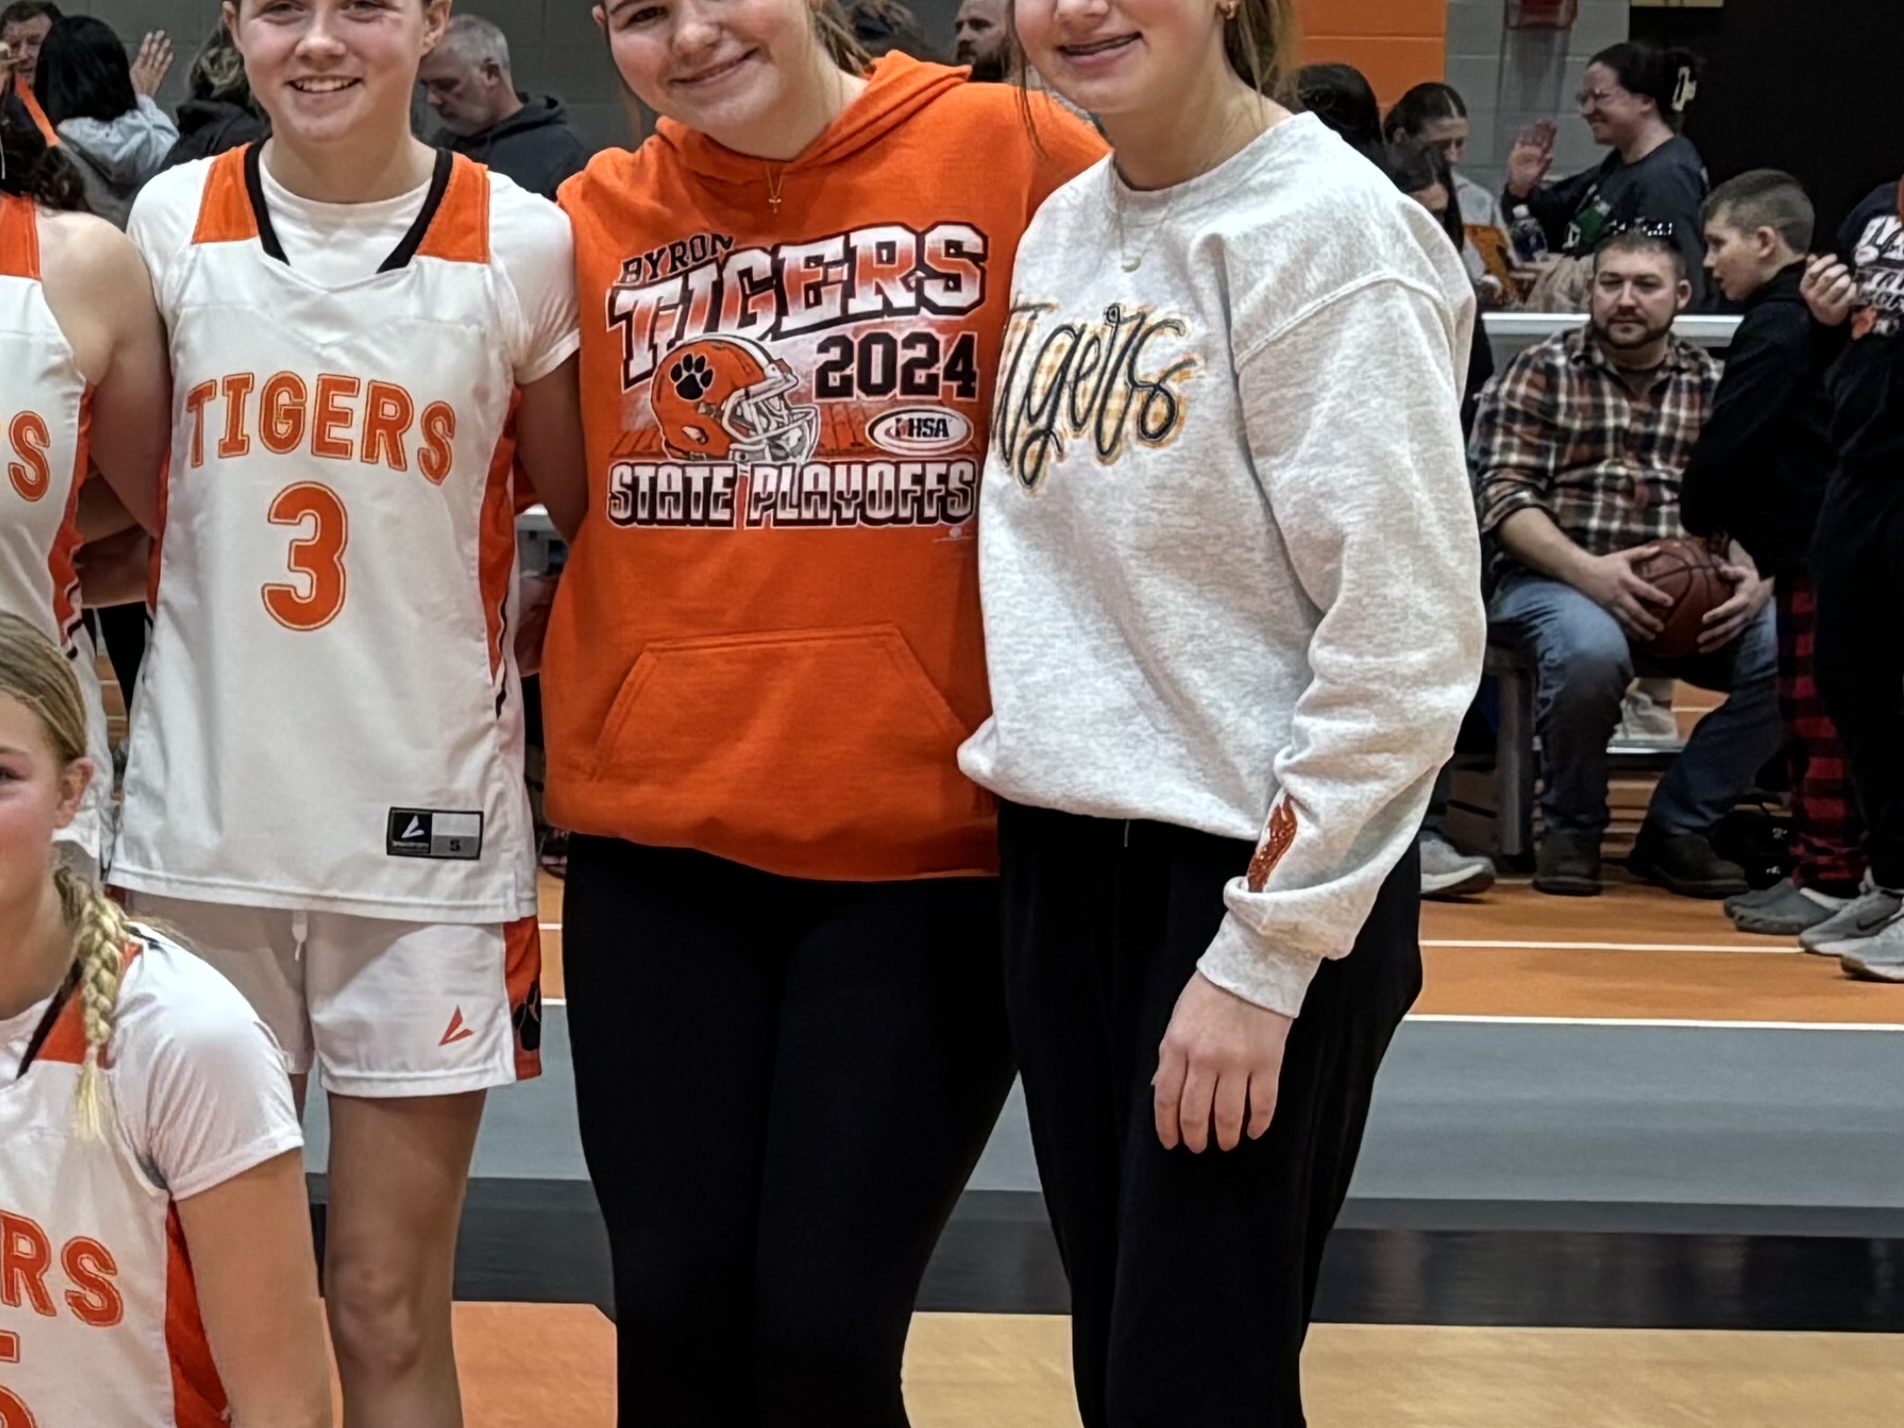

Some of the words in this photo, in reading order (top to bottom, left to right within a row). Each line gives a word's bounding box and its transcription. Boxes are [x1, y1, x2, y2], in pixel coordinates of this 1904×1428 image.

[607, 224, 986, 387] TIGERS
[620, 233, 734, 284] BYRON
[816, 332, 979, 400] 2024
[991, 292, 1200, 490] Tigers
[185, 371, 456, 486] TIGERS
[607, 461, 735, 526] STATE
[747, 460, 977, 526] PLAYOFFS
[261, 481, 348, 631] 3
